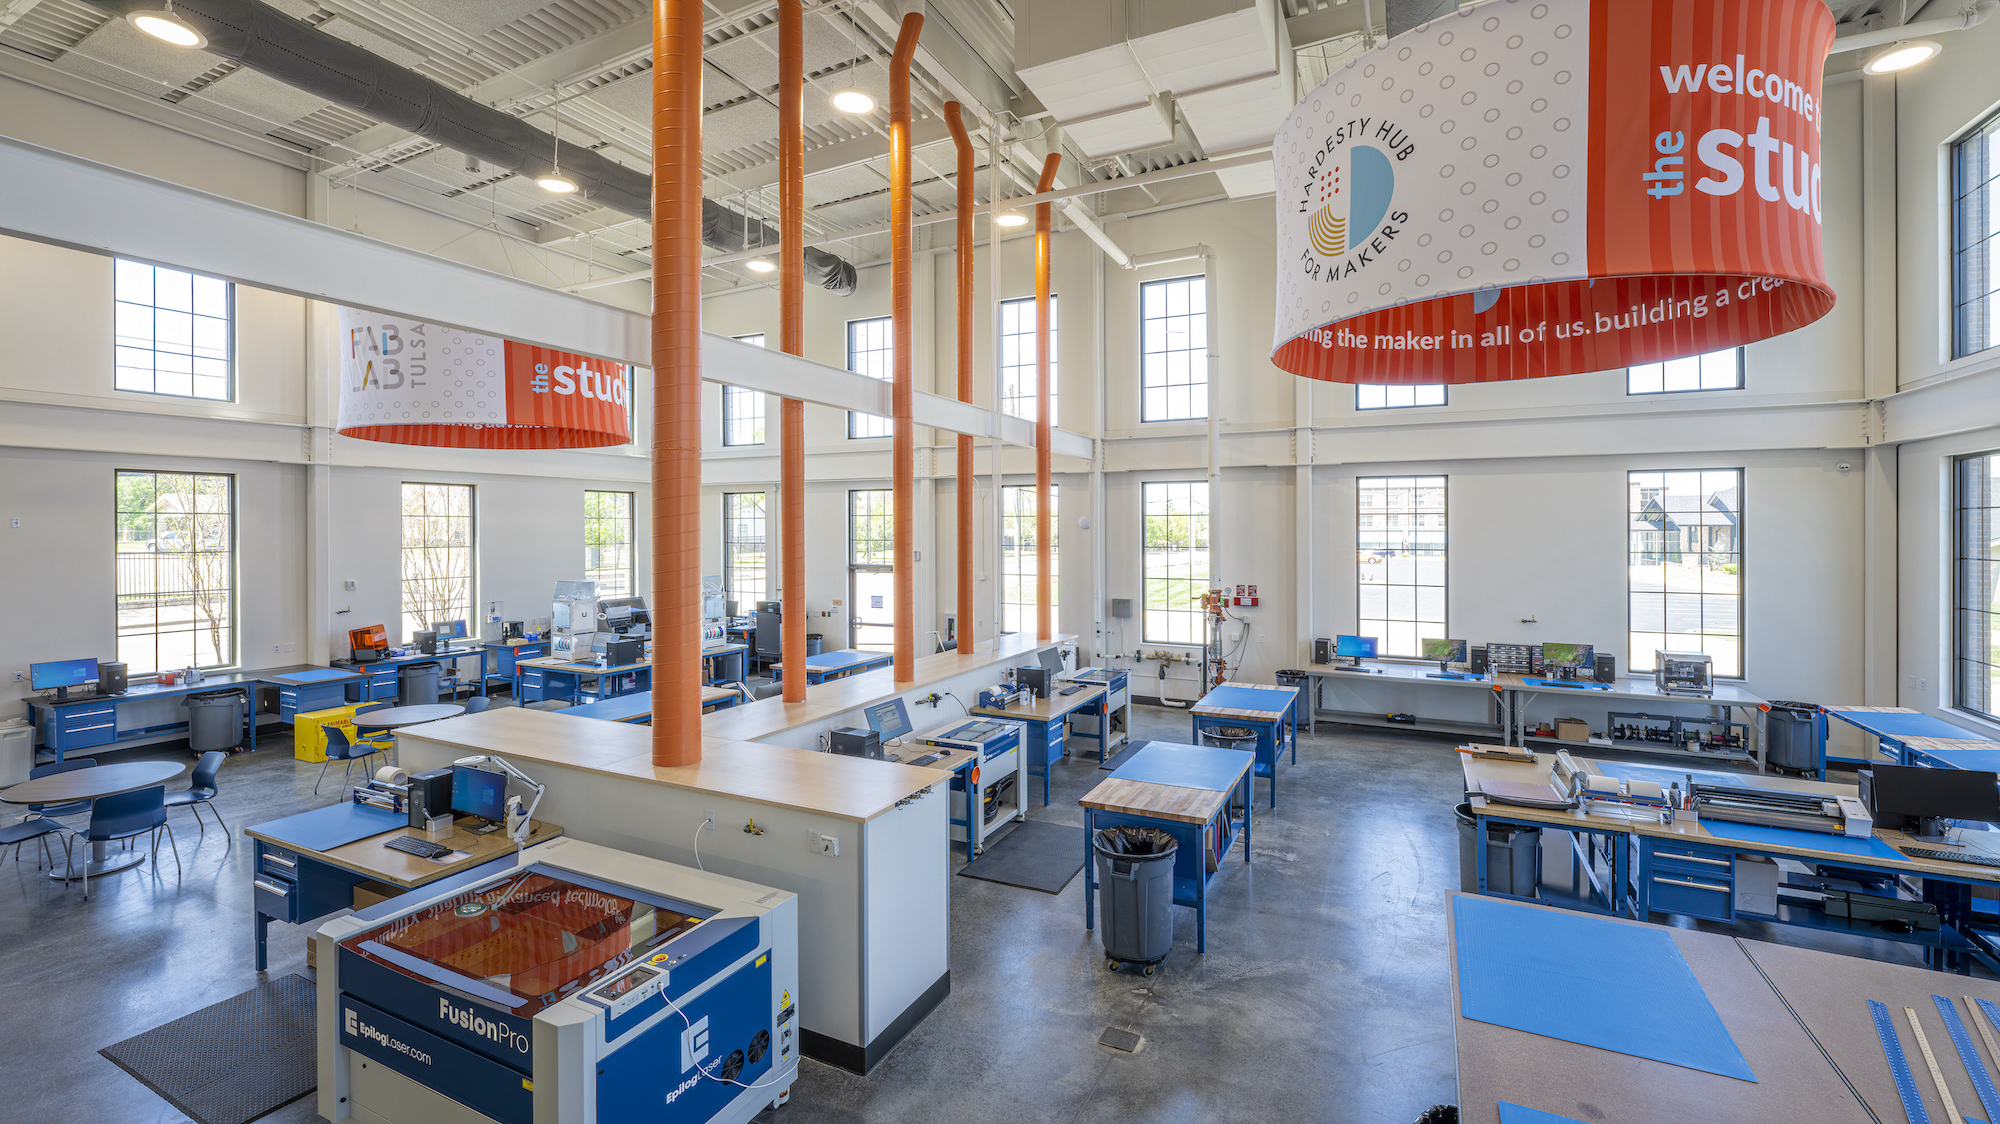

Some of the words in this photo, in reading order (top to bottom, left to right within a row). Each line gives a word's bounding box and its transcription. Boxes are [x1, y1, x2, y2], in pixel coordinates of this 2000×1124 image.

[1660, 54, 1813, 122] welcome
[1815, 97, 1821, 135] t
[1299, 117, 1371, 213] HARDESTY
[1375, 120, 1415, 161] HUB
[1643, 130, 1684, 200] the
[1301, 249, 1321, 281] FOR
[1326, 210, 1408, 283] MAKERS
[351, 324, 404, 360] FAB
[1337, 327, 1368, 349] the
[1374, 330, 1444, 350] maker
[1451, 330, 1473, 349] in
[1480, 325, 1509, 347] all
[1519, 320, 1547, 343] of
[1595, 295, 1708, 334] building
[1716, 288, 1730, 307] a
[409, 323, 427, 389] TULSA
[530, 363, 550, 394] the
[359, 1021, 433, 1066] EpilogLaser.com
